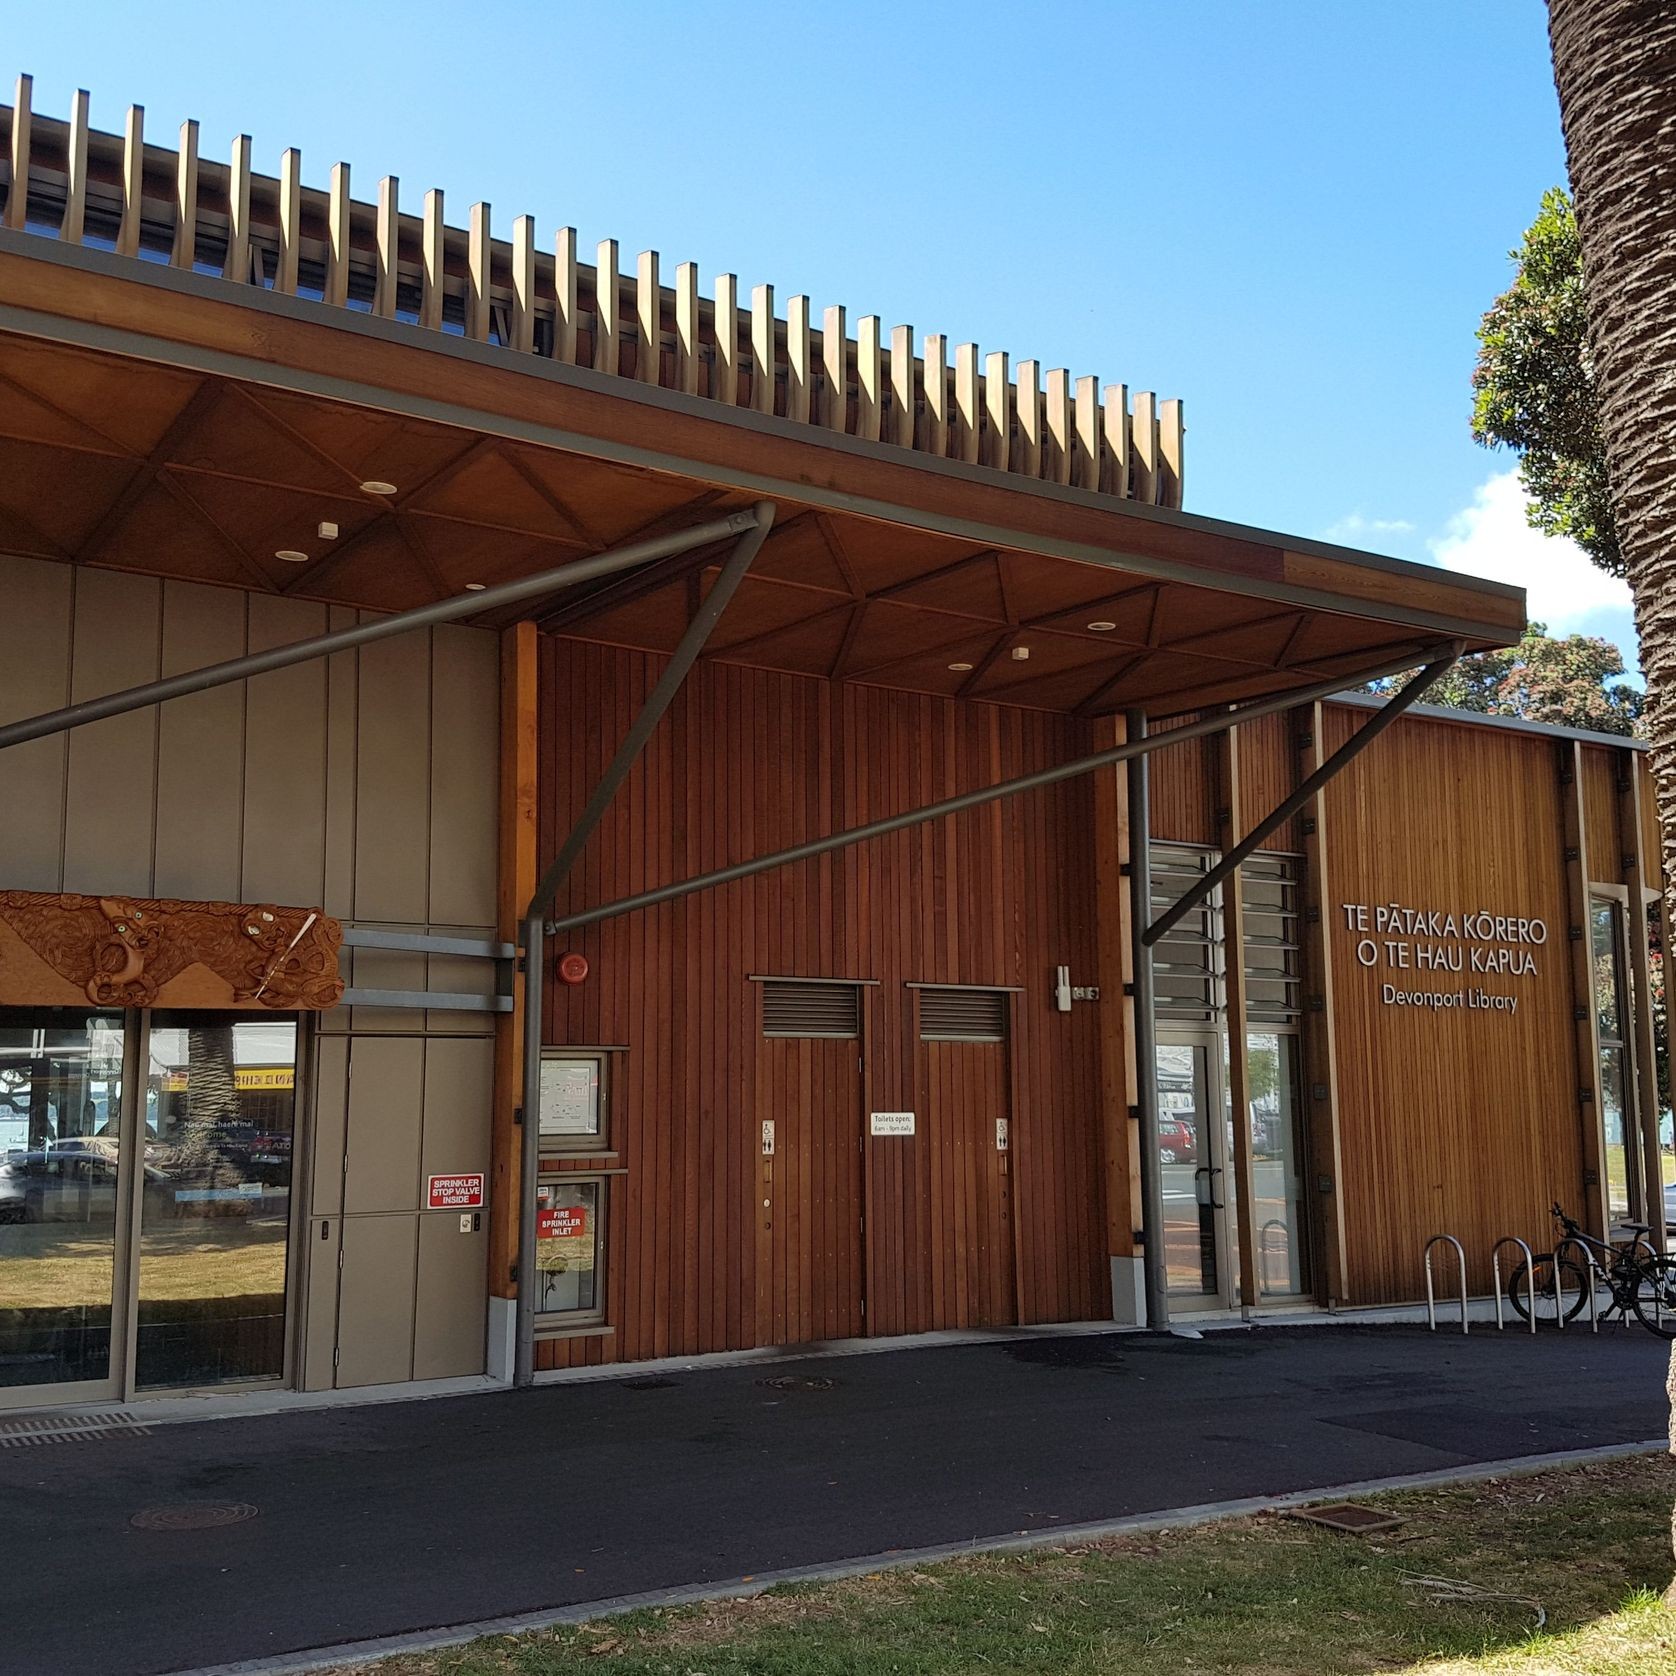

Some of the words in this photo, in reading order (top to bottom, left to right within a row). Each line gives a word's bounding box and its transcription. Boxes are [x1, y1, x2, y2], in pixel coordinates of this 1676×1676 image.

[1343, 904, 1369, 932] TE
[1376, 903, 1459, 938] PĀTAKA
[1463, 911, 1547, 945] KŌRERO
[1357, 939, 1378, 967] O
[1384, 941, 1409, 968] TE
[1417, 943, 1463, 972] HAU
[1471, 947, 1538, 976] KAPUA
[1382, 984, 1463, 1011] Devonport
[1468, 988, 1518, 1015] Library
[874, 1115, 894, 1123] Toilets
[433, 1178, 480, 1189] SPRINKLER
[432, 1188, 455, 1197] STOP
[455, 1186, 480, 1195] VALVE
[442, 1195, 470, 1204] INSIDE
[553, 1210, 570, 1219] FIRE
[541, 1218, 581, 1228] SPRINKLER
[552, 1227, 572, 1236] INLET
